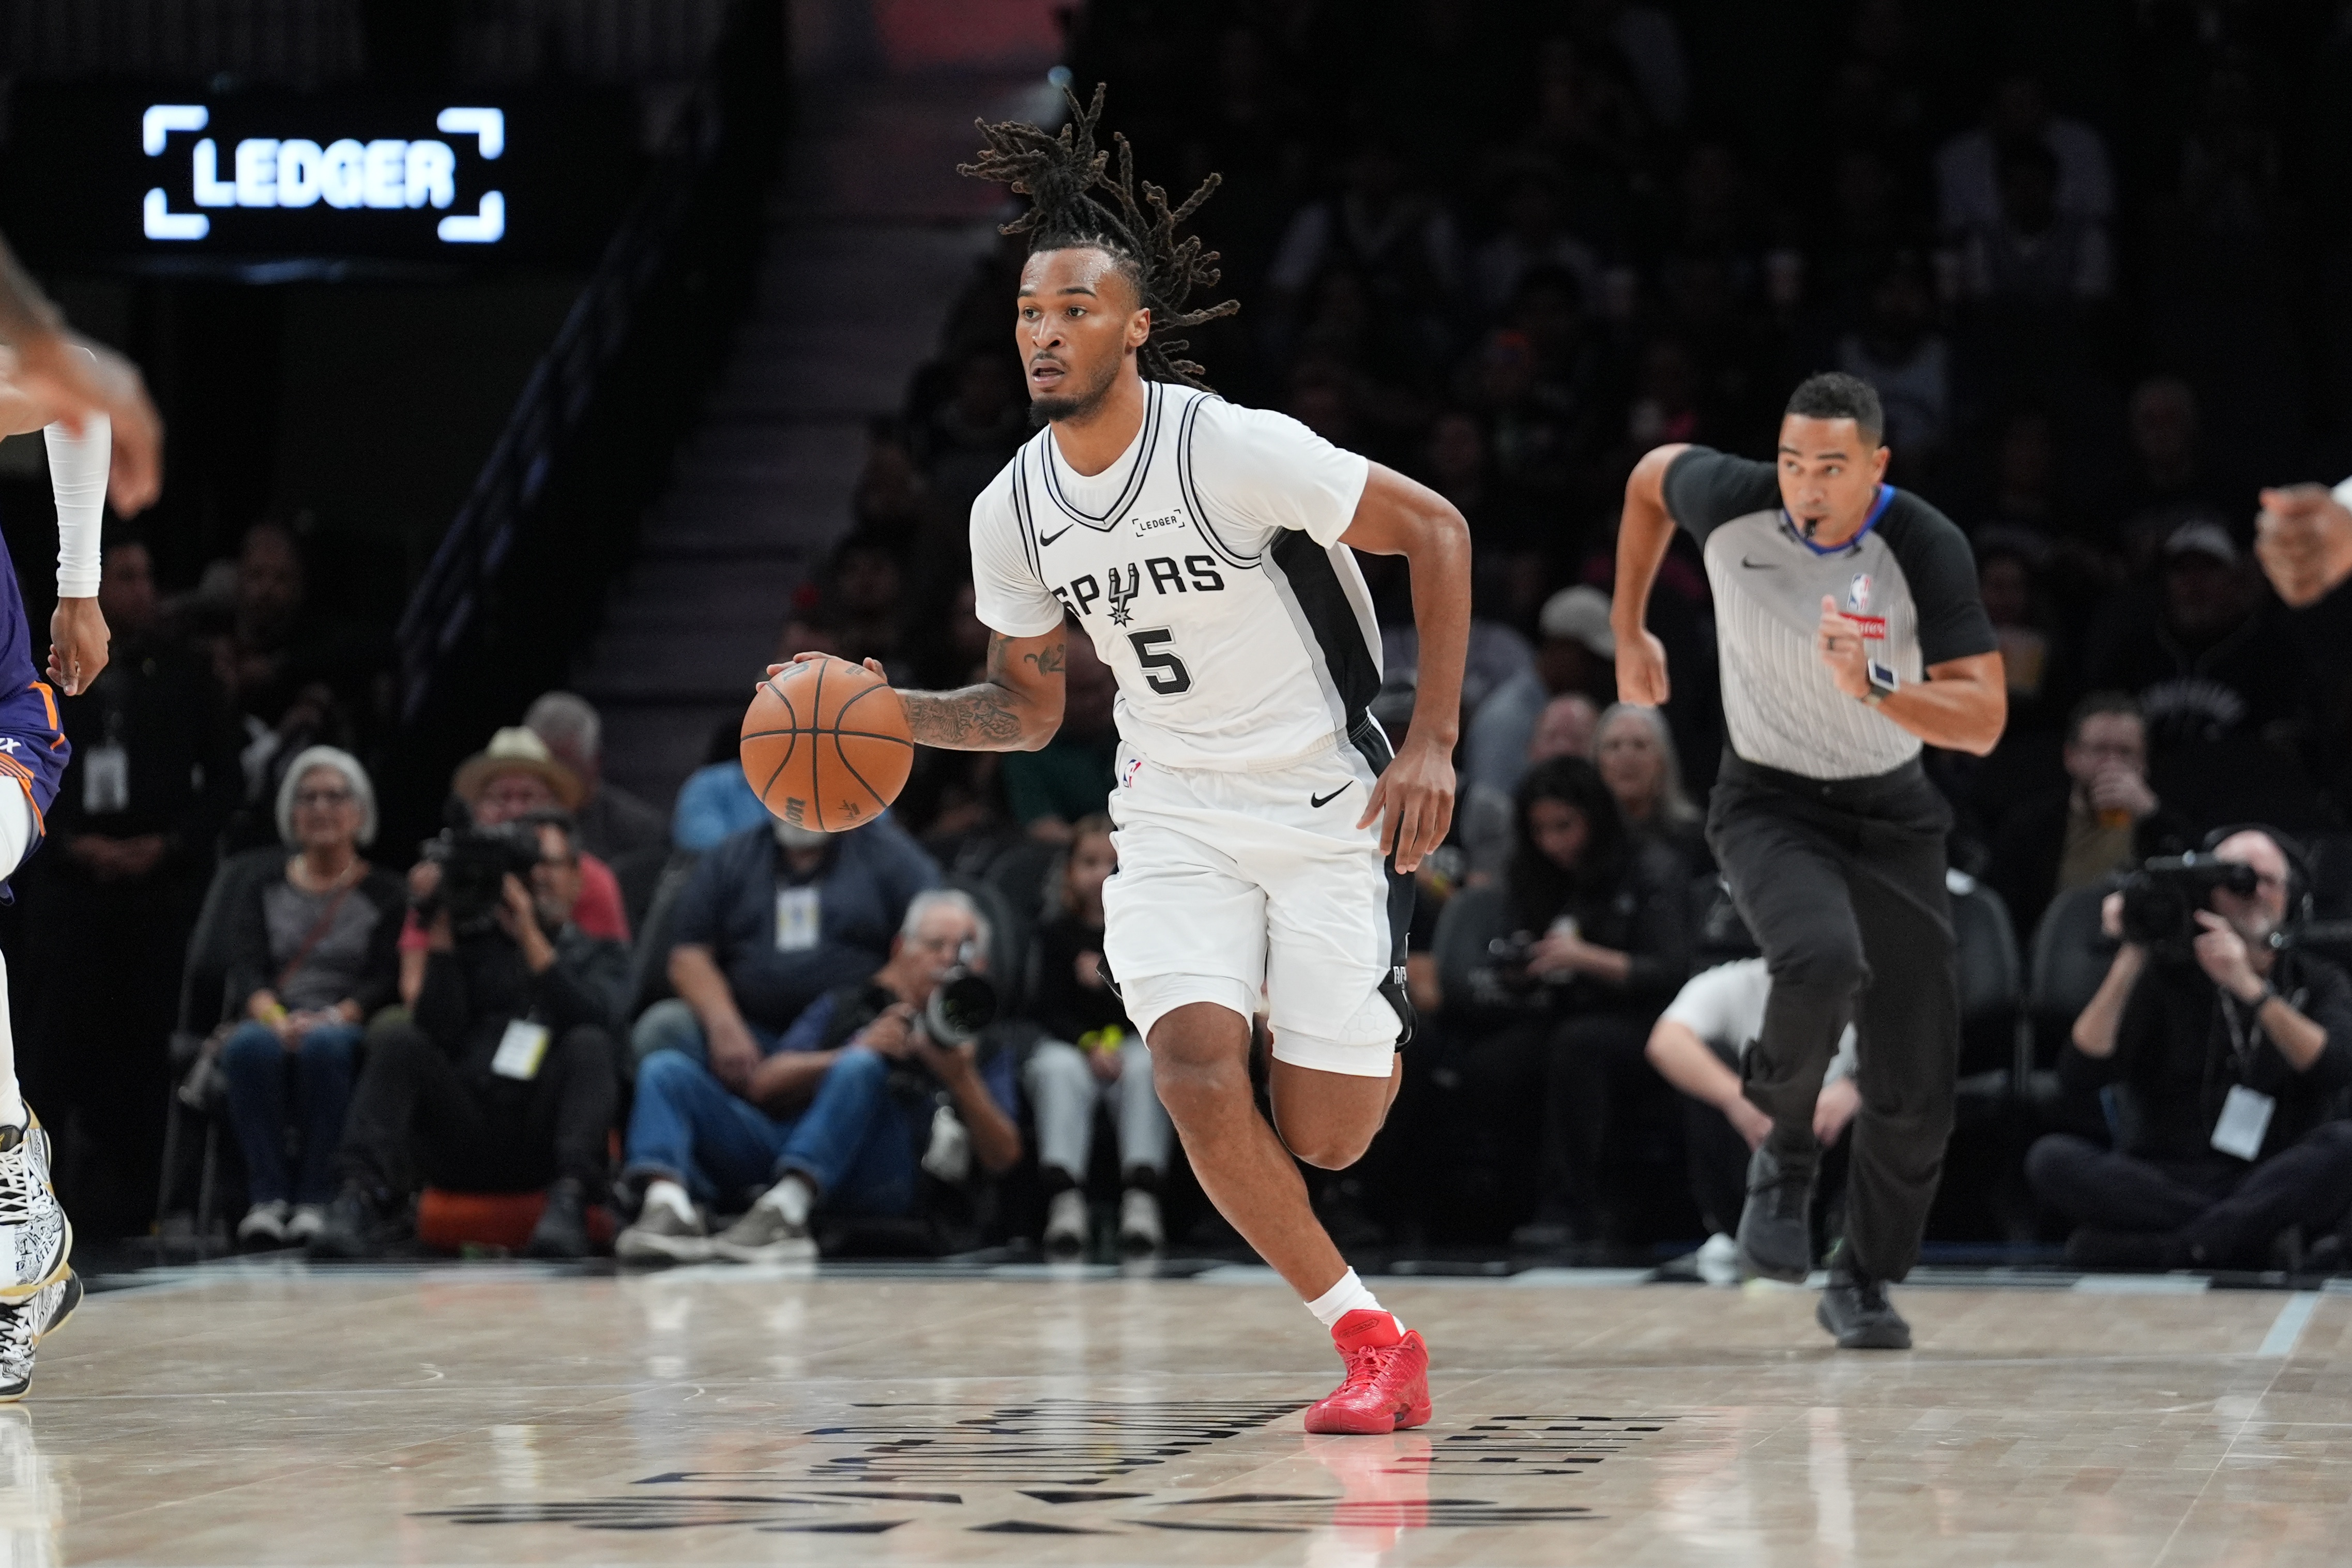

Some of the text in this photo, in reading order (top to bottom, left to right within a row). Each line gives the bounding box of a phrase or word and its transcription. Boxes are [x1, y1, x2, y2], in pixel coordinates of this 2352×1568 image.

[193, 138, 456, 208] LEDGER
[1140, 516, 1177, 530] LEDGER
[1125, 625, 1194, 696] 5
[628, 1399, 1318, 1485] Frost Bank
[1375, 1415, 1718, 1475] CENTER
